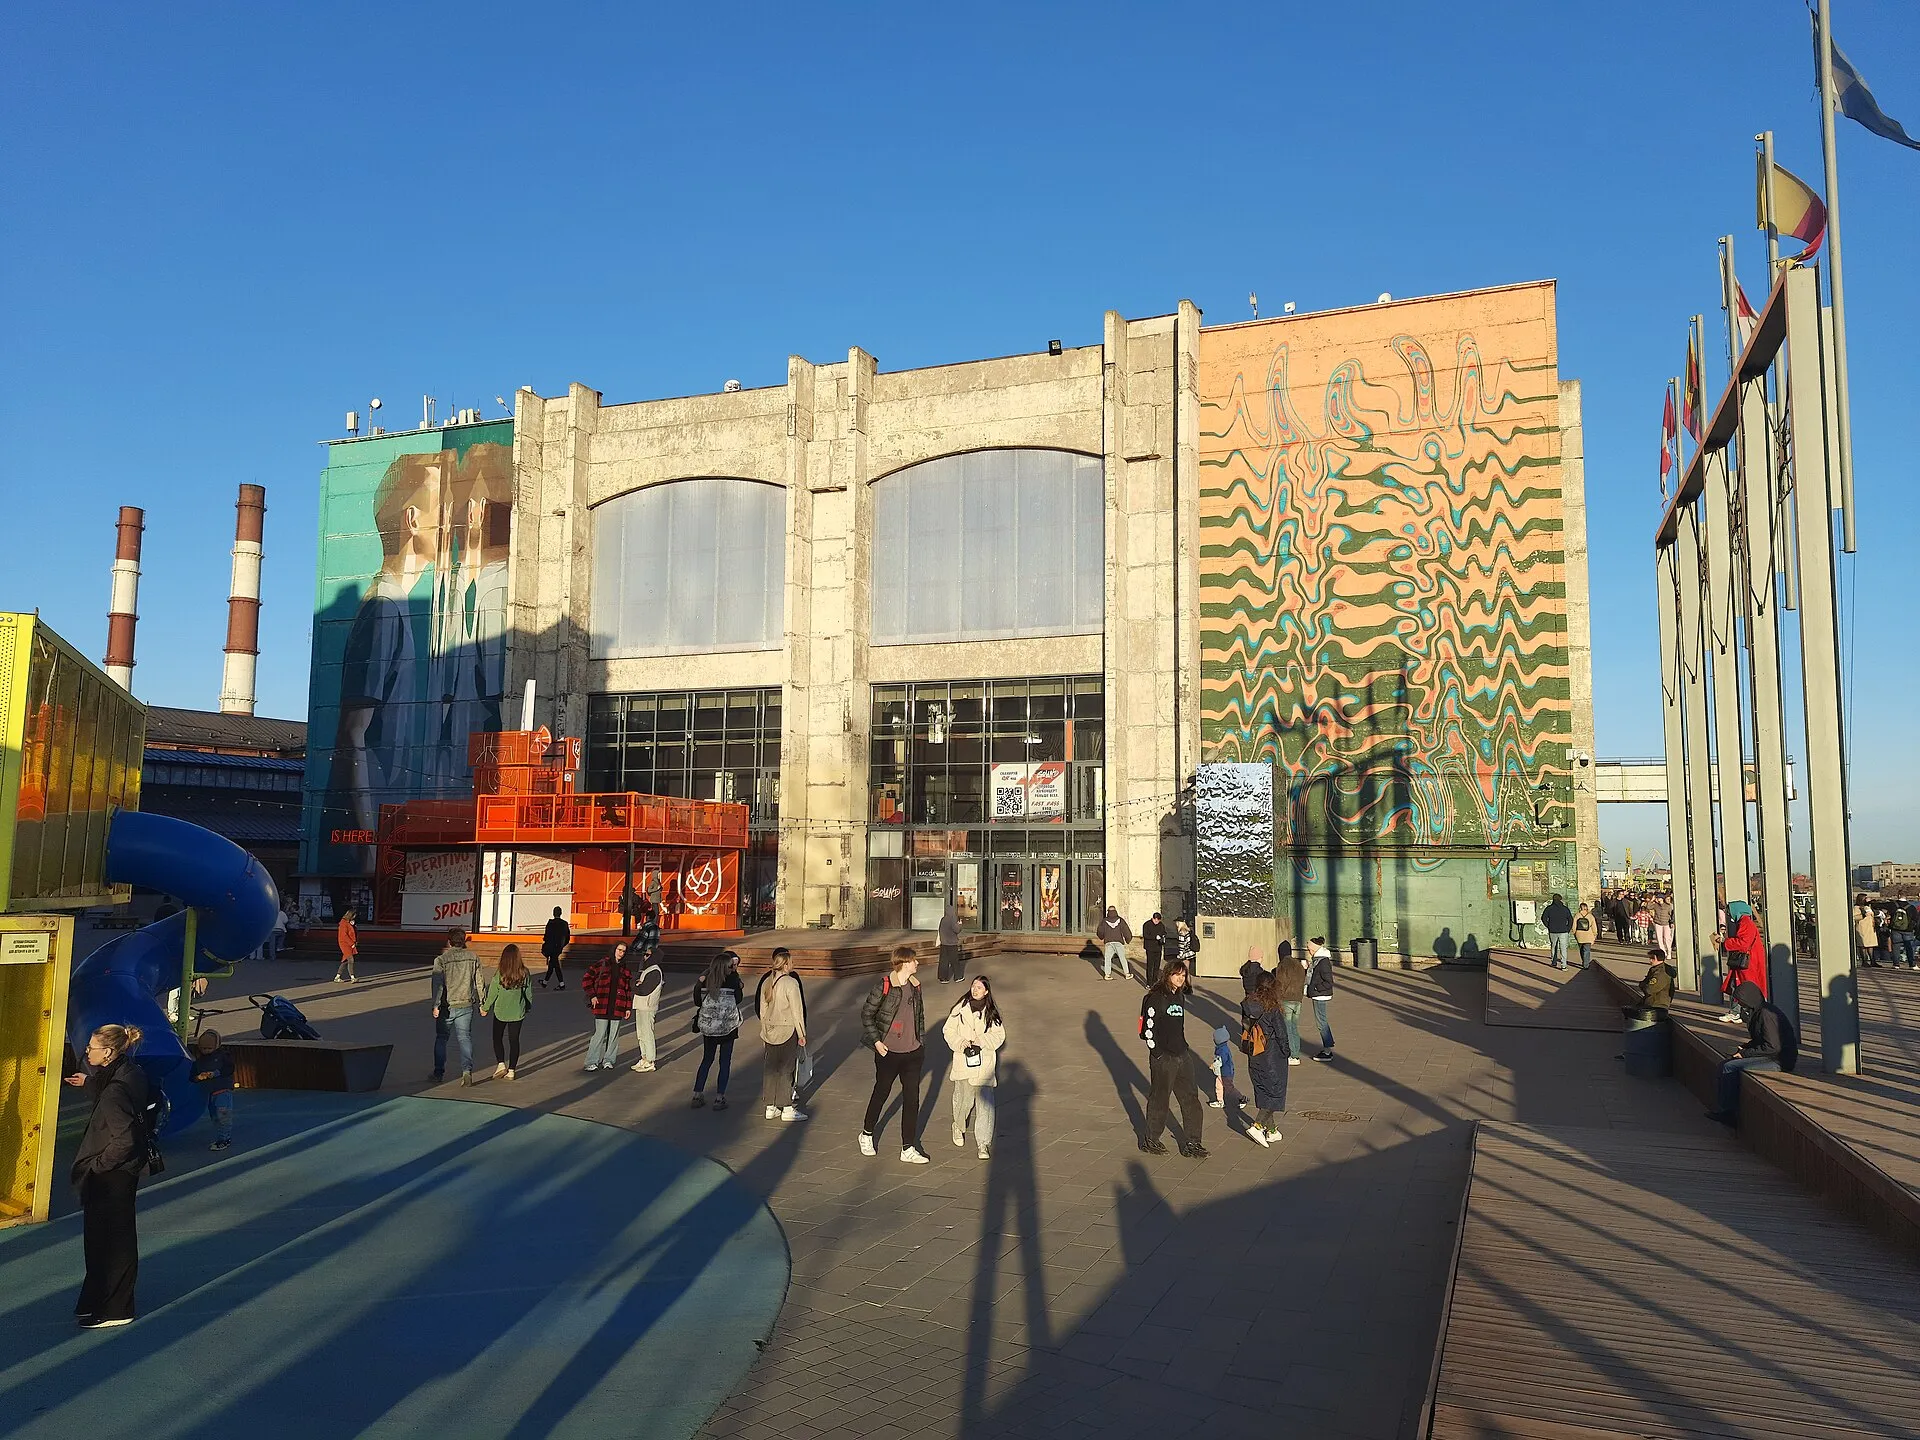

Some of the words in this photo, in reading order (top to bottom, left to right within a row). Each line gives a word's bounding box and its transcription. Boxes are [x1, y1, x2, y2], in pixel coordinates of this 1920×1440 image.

[331, 830, 340, 842] IS
[343, 829, 373, 842] HERE
[523, 866, 554, 888] SPRITZ
